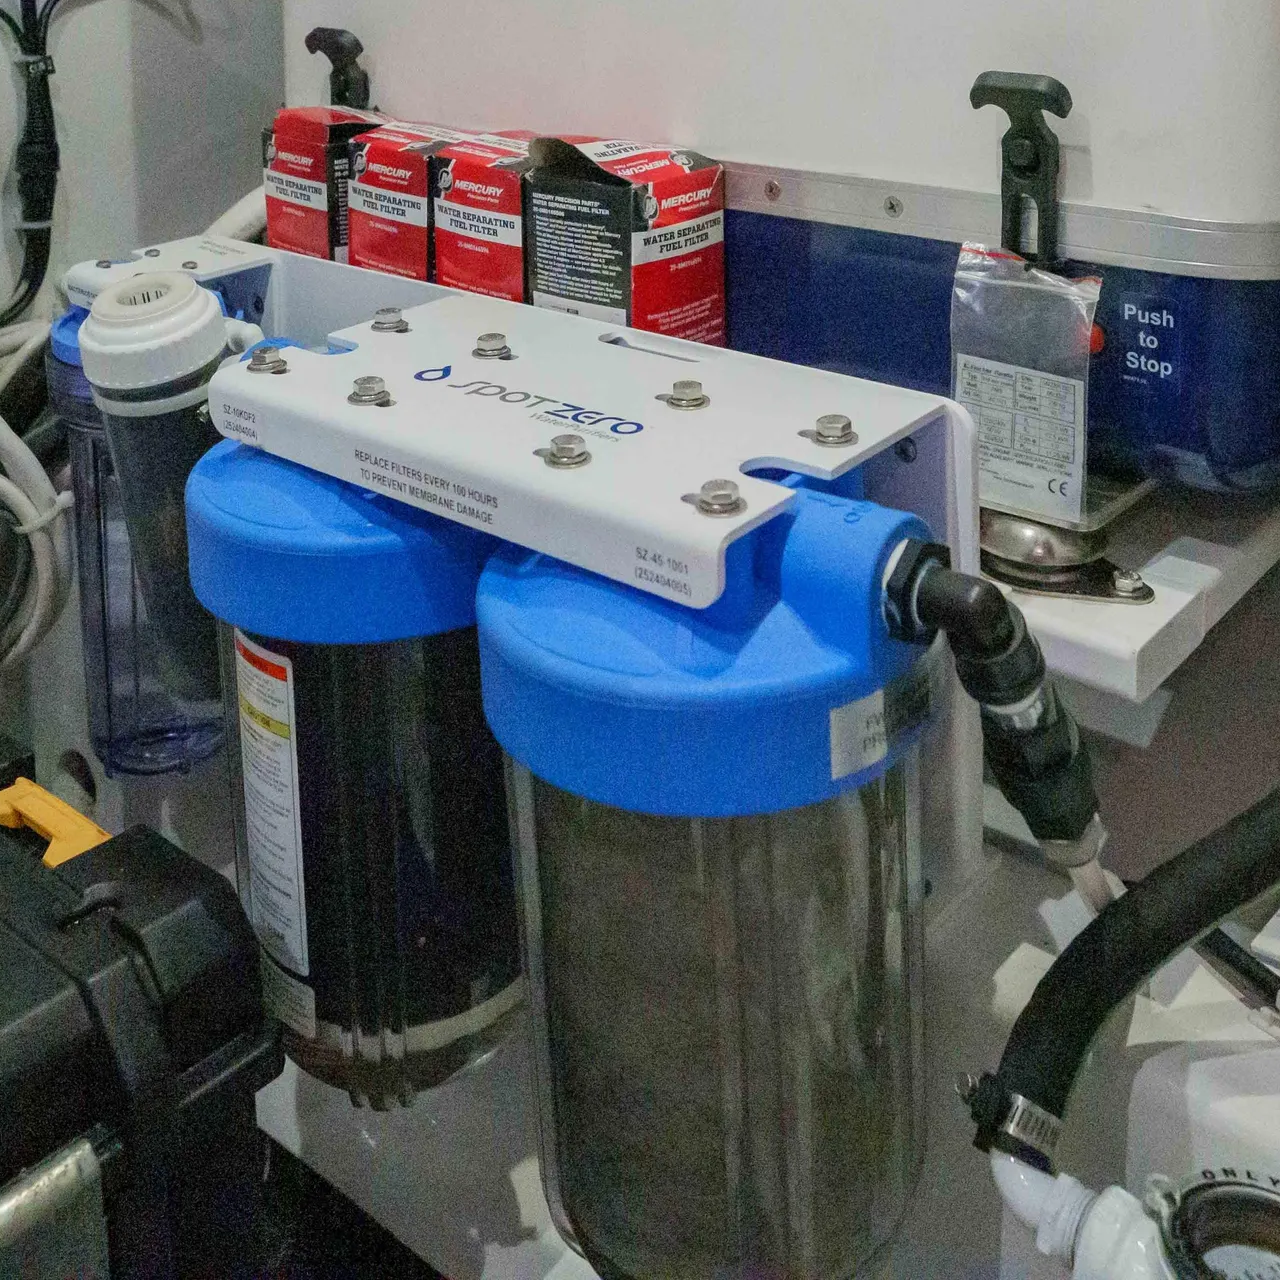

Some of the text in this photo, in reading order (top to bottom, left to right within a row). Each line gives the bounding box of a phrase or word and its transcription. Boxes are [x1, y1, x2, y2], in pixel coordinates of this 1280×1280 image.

[277, 150, 314, 167] MERCURY
[617, 158, 671, 177] MERCURY
[369, 161, 413, 180] MERCURY
[275, 186, 312, 203] FUEL FILTER
[285, 178, 322, 196] SEPARATING
[454, 179, 504, 198] MERCURY
[352, 186, 422, 211] WATER SEPARATING
[363, 199, 407, 217] FUEL FILTER
[661, 188, 713, 210] MERCURY
[437, 204, 461, 218] WATER
[462, 210, 516, 230] SEPARATING
[591, 207, 610, 216] FILTER
[449, 218, 498, 237] FUEL FILTER
[643, 216, 721, 247] WATER SEPARATING
[659, 231, 709, 254] FUEL FILTER
[1124, 303, 1174, 329] Push
[1139, 330, 1159, 350] to
[1125, 351, 1173, 379] Stop
[354, 449, 499, 509] REPLACE FILTERS EVERY 100 HOURS
[360, 467, 494, 525] TO PREVENT MEMBRANE DAMAGE
